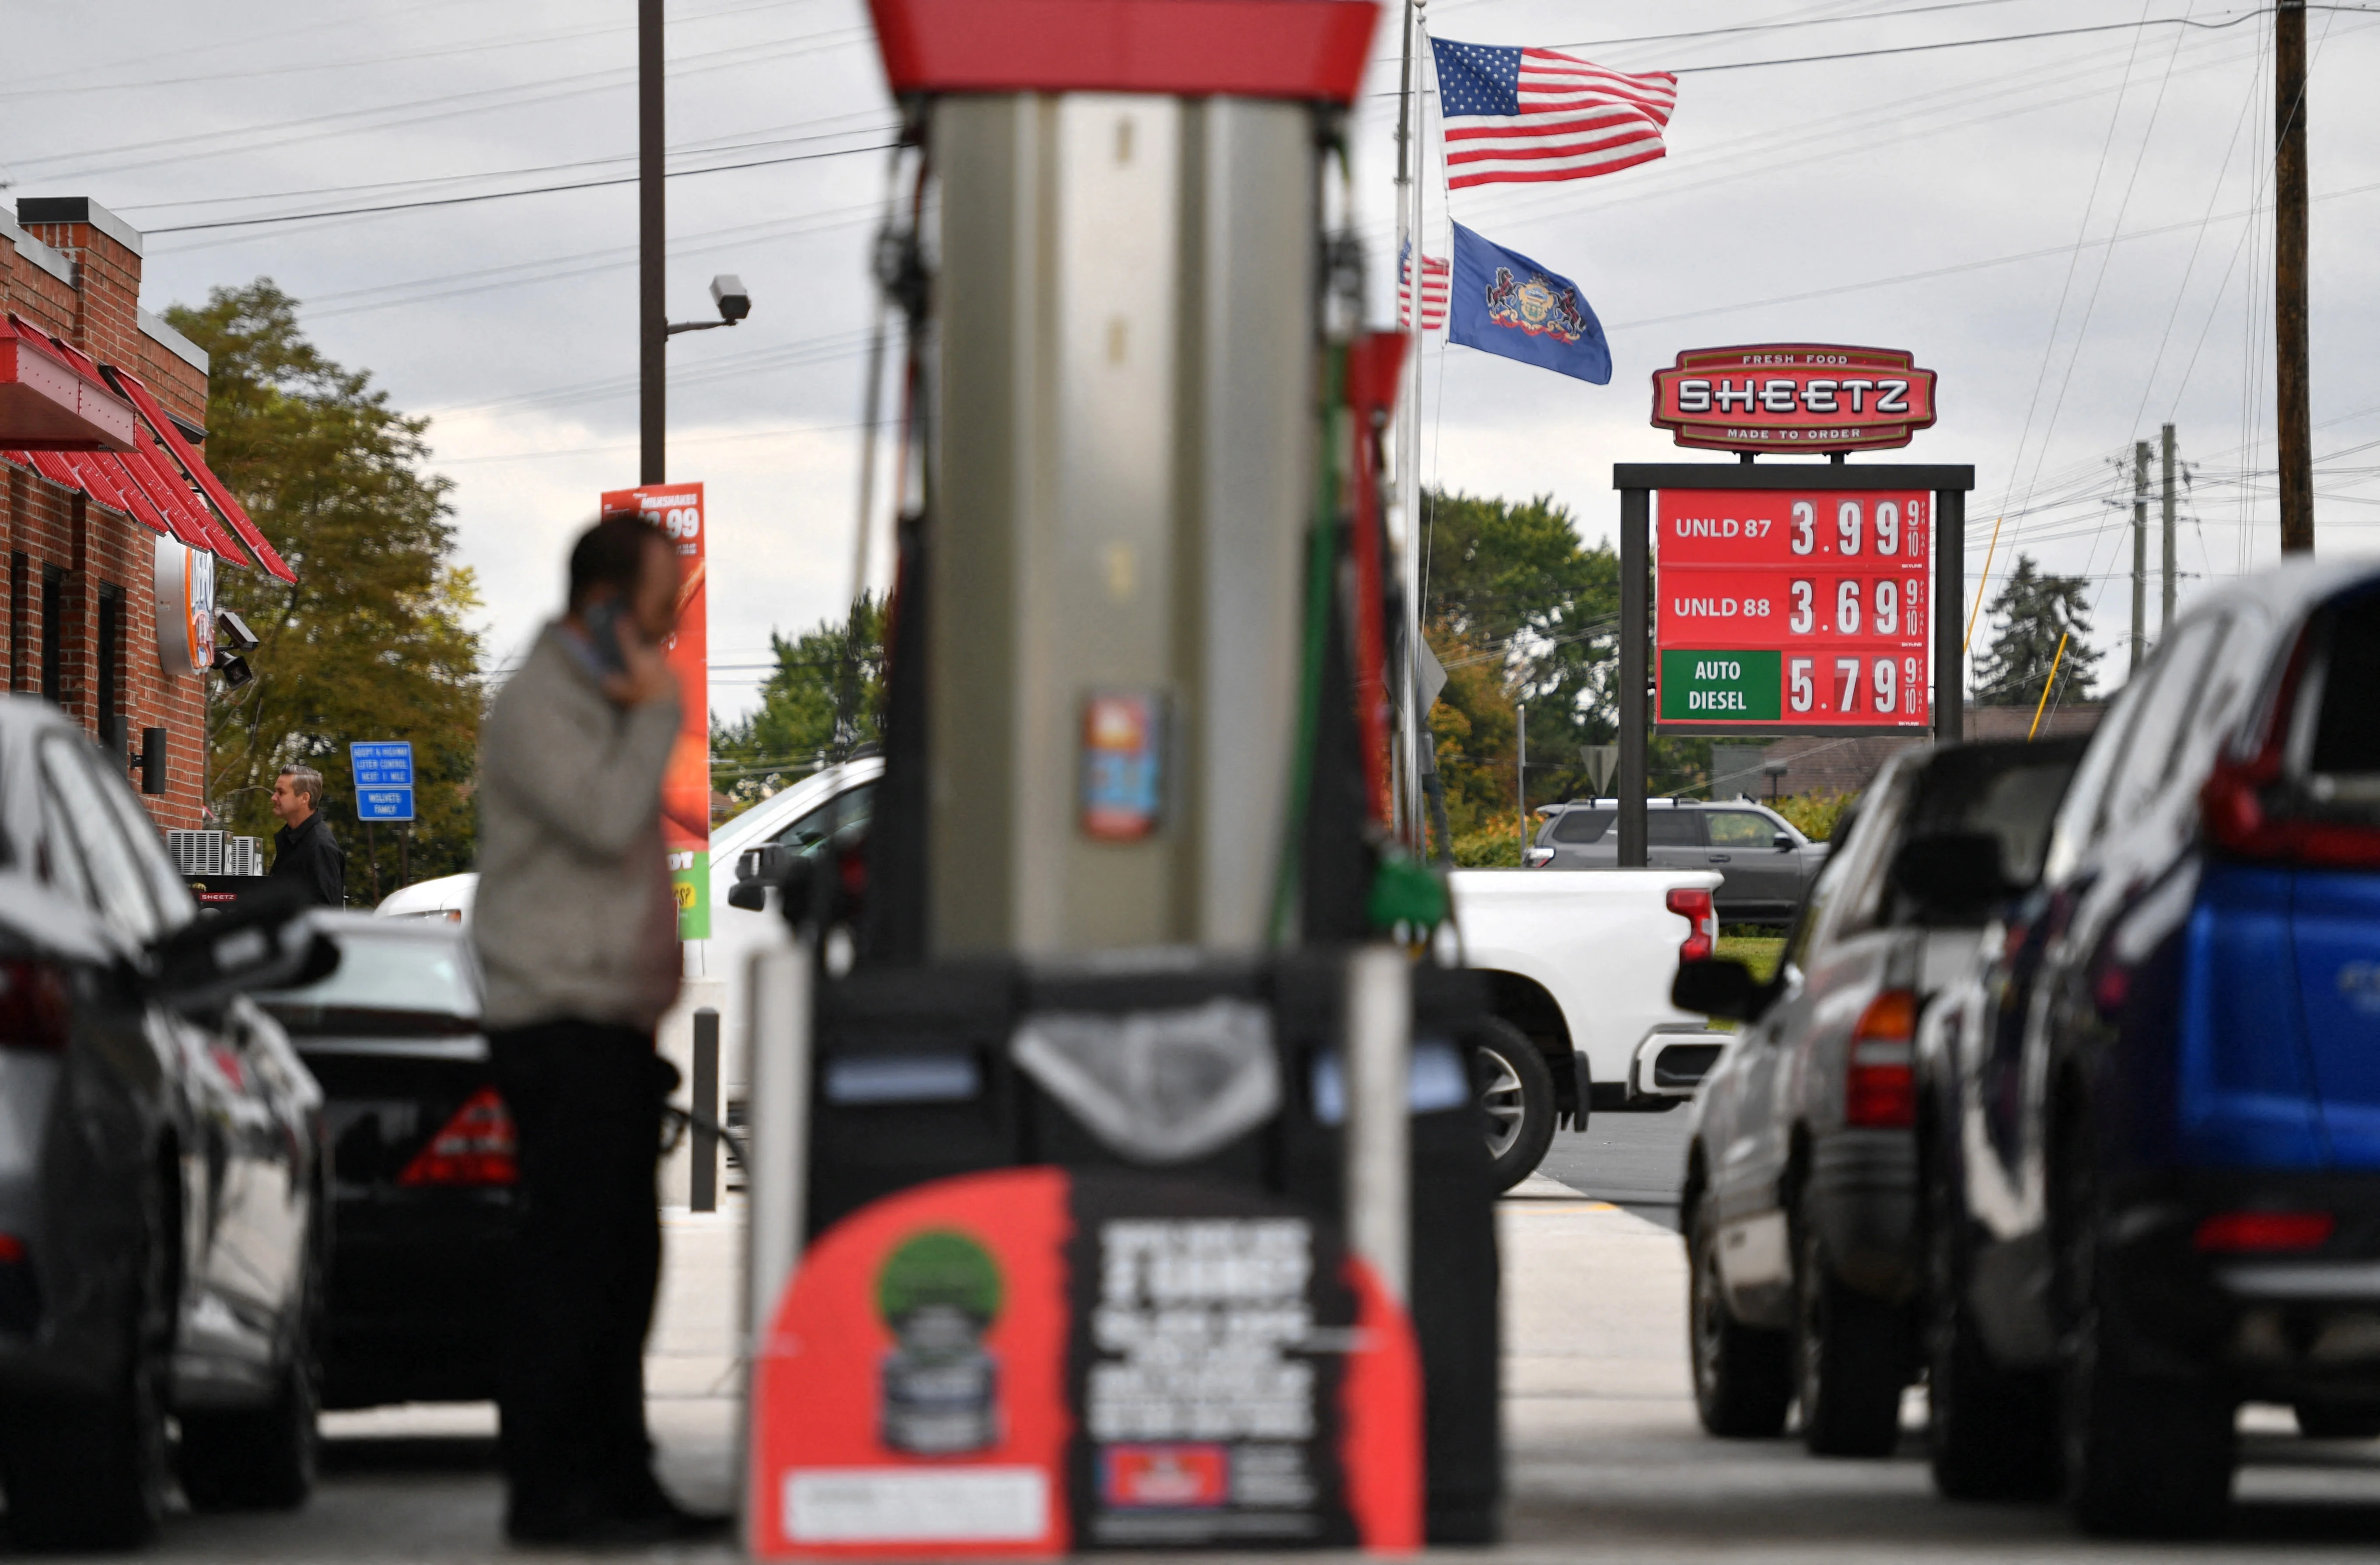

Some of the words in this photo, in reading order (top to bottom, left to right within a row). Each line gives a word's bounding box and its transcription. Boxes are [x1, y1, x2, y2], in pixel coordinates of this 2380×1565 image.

[1743, 355, 1794, 364] FRESH
[1807, 355, 1848, 364] FOOD
[1679, 380, 1908, 412] SHEETZ
[1727, 429, 1768, 439] MADE
[1779, 430, 1799, 439] TO
[1808, 429, 1861, 439] ORDER
[640, 494, 697, 509] MILKSHAKES
[1676, 518, 1739, 538] UNLD
[1745, 519, 1772, 538] 87
[1792, 501, 1898, 555] 3.99
[1674, 598, 1738, 617] UNLD
[1743, 598, 1770, 617] 88
[1791, 580, 1898, 634] 3.69
[1695, 661, 1740, 680] AUTO
[1791, 659, 1896, 713] 5.79
[1689, 691, 1747, 710] DIESEL
